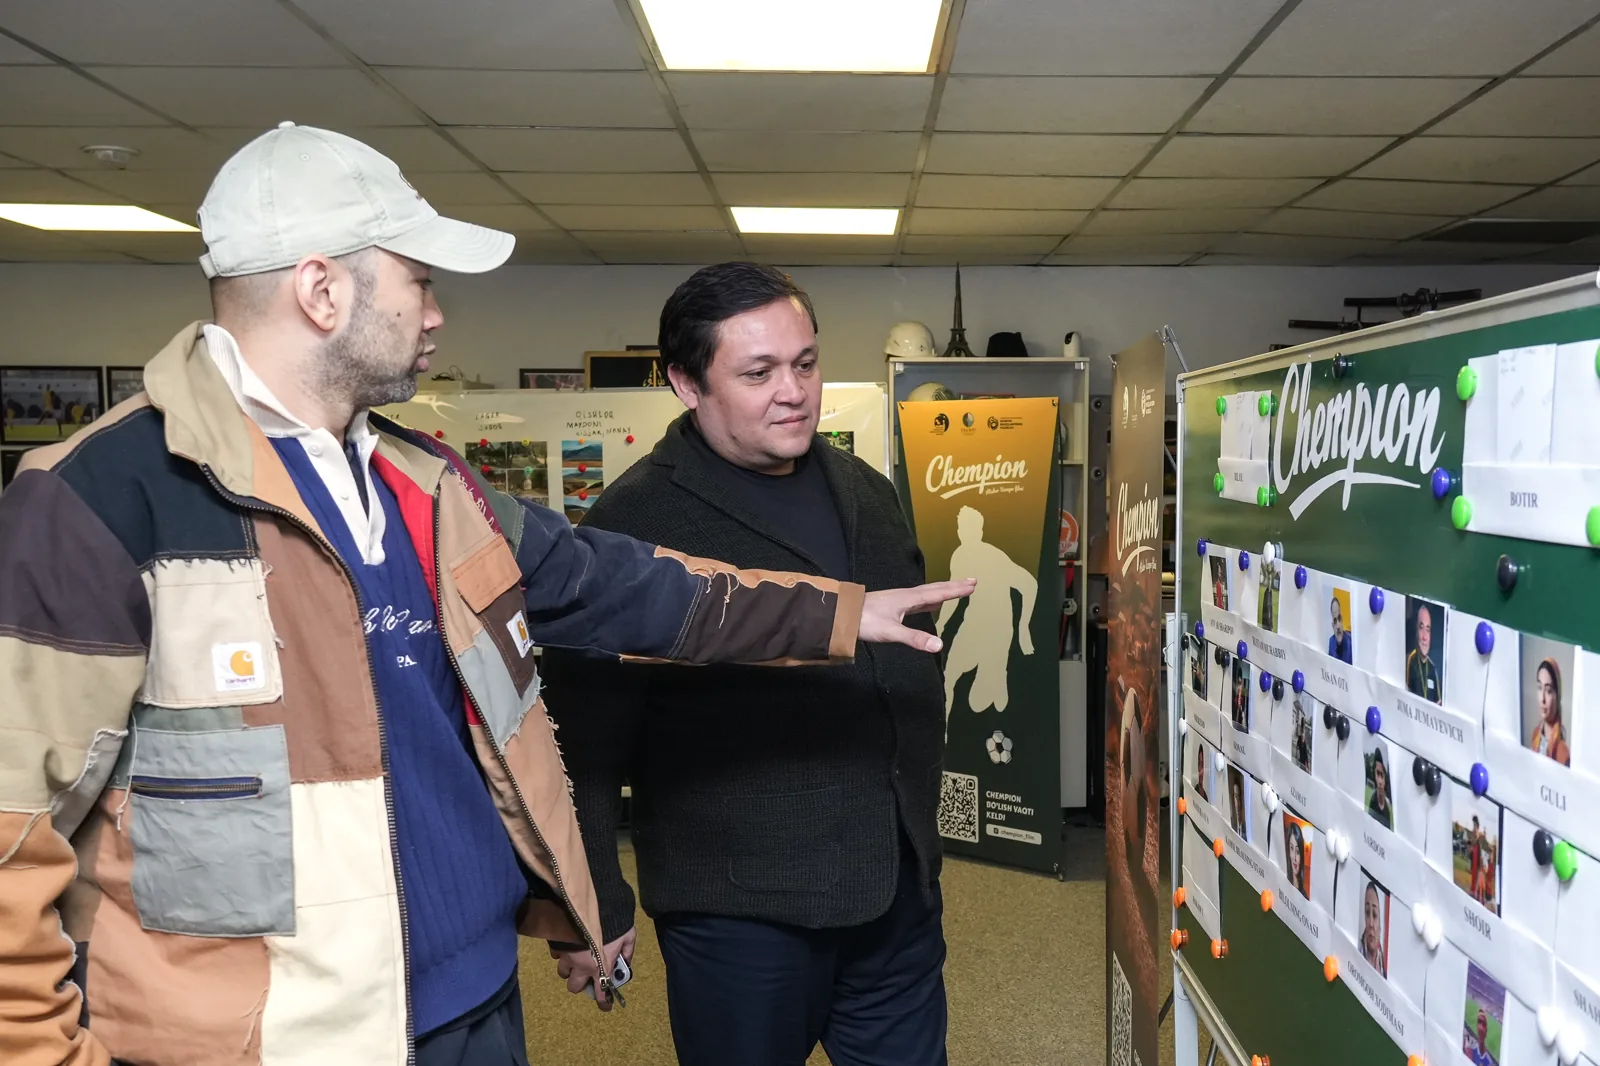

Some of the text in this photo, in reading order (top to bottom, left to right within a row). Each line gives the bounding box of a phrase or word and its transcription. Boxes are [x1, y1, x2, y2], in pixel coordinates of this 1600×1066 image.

[1273, 361, 1446, 514] Chempion
[925, 454, 1028, 496] Chempion
[1510, 491, 1538, 508] BOTIR
[1116, 482, 1160, 573] Chempion
[1414, 707, 1464, 744] JUMAYEVICH
[985, 790, 1022, 803] CHEMPION
[1013, 805, 1034, 816] VAQTI
[1540, 784, 1567, 812] GULI
[986, 811, 1006, 821] KELDI
[1464, 905, 1492, 941] SHOIR
